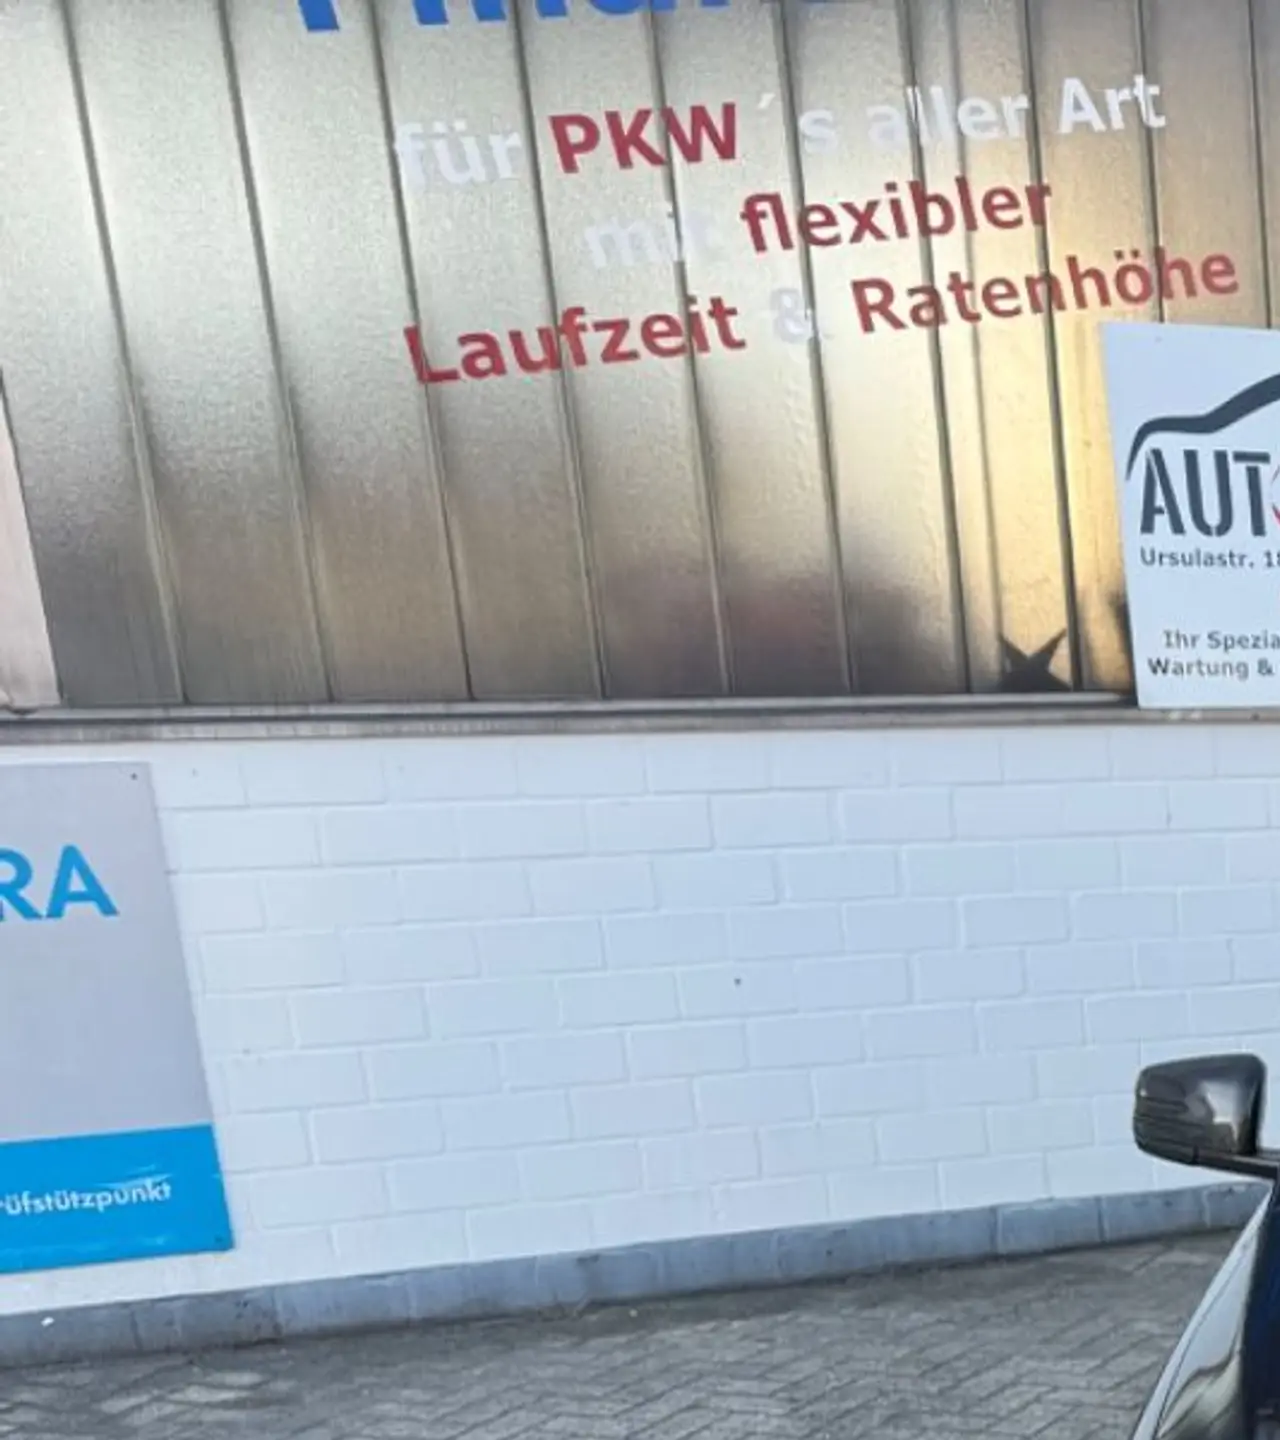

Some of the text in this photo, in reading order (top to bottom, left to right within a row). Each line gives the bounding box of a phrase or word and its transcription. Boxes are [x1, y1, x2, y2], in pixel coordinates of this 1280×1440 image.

[395, 120, 523, 192] für
[549, 102, 739, 175] PKW
[866, 85, 1029, 147] aller
[1057, 72, 1166, 138] Art
[740, 178, 1053, 254] flexibler
[403, 295, 748, 384] Laufzeit
[851, 246, 1240, 333] Ratenhöhe
[1140, 548, 1254, 569] Ursulastr.
[1163, 630, 1200, 650] Ihr
[1148, 658, 1248, 682] Wartung
[1257, 659, 1274, 677] &
